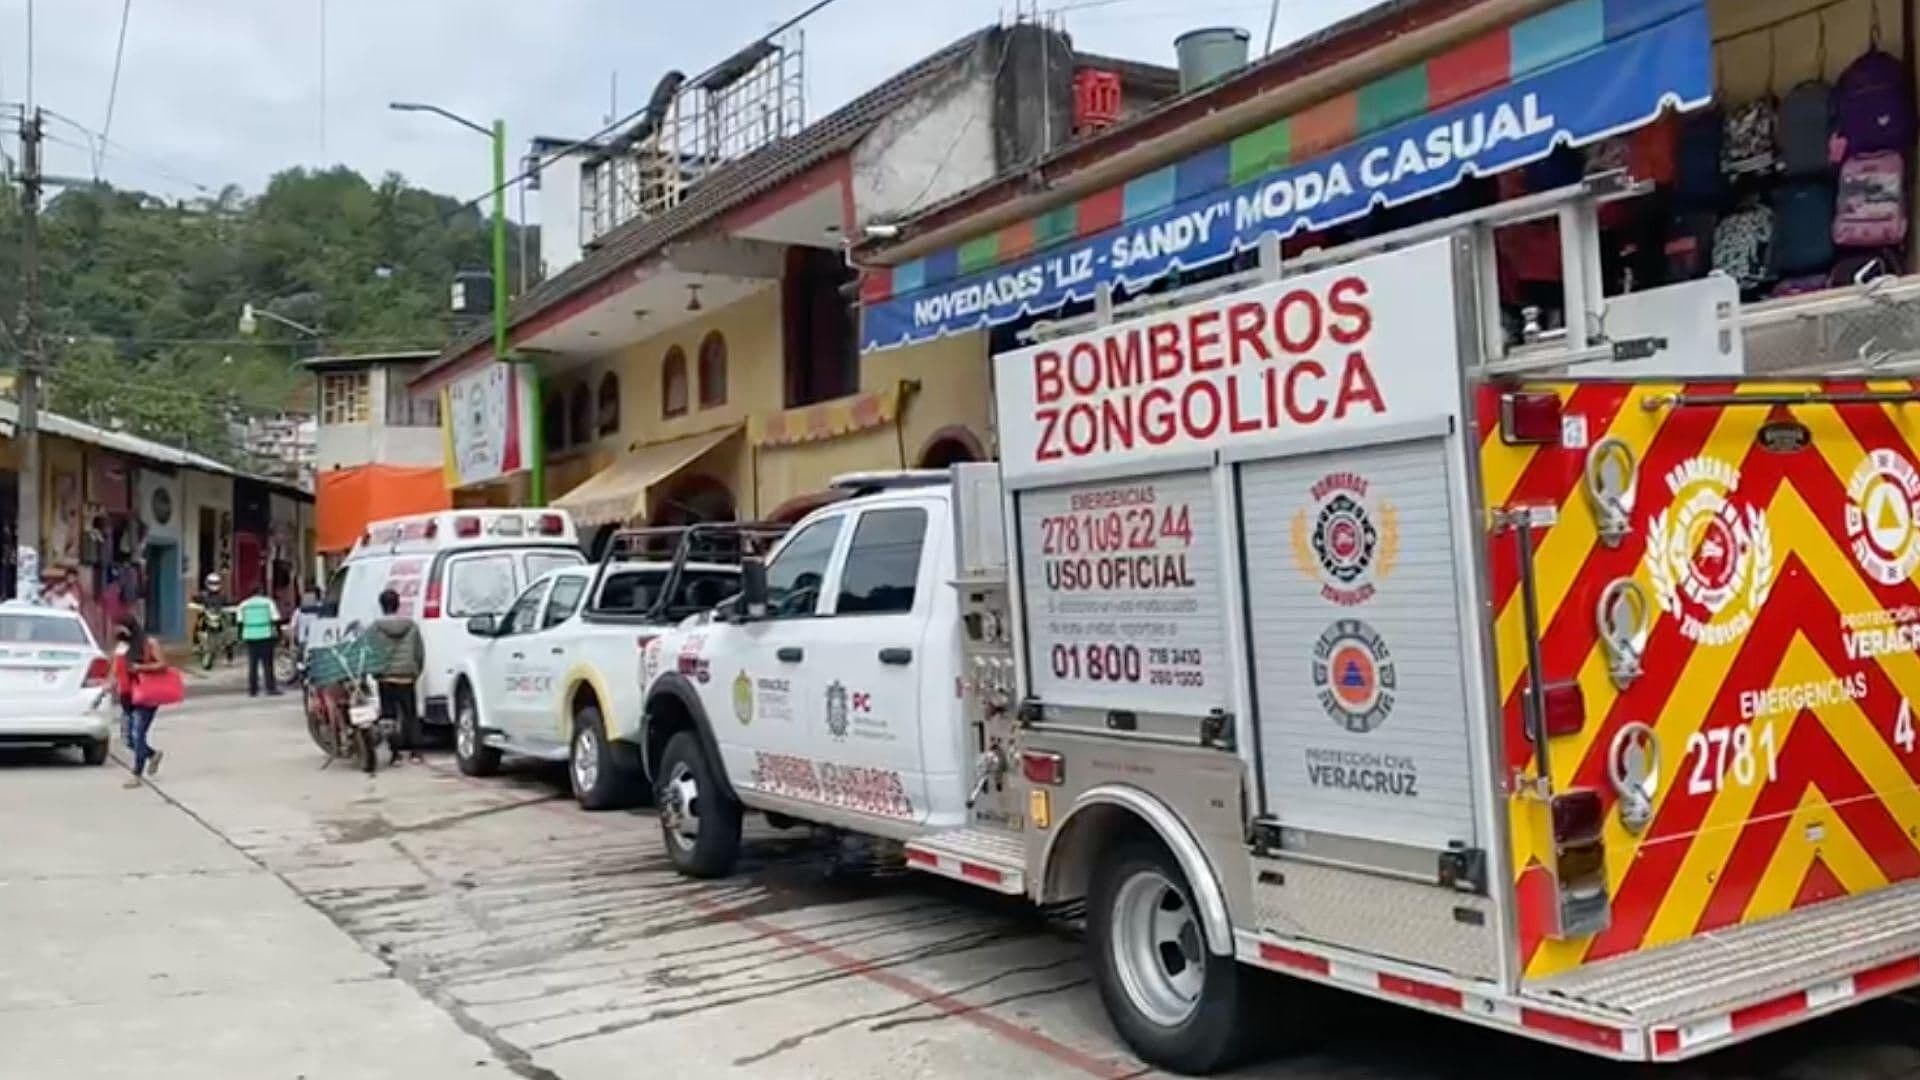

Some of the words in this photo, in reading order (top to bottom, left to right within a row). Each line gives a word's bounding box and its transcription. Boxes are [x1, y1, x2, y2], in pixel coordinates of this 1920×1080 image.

[913, 264, 1042, 327] NOVEDADES
[1236, 161, 1354, 231] MODA
[1360, 92, 1555, 188] CASUAL
[1034, 276, 1373, 404] BOMBEROS
[1035, 351, 1387, 462] ZONGOLICA
[1071, 486, 1156, 511] EMERGENCIAS
[1047, 559, 1092, 590] USO
[1099, 554, 1196, 589] OFICIAL
[1052, 643, 1081, 680] 01
[1087, 643, 1141, 683] 800
[1739, 671, 1867, 719] EMERGENCIAS
[1307, 763, 1418, 797] VERACRUZ
